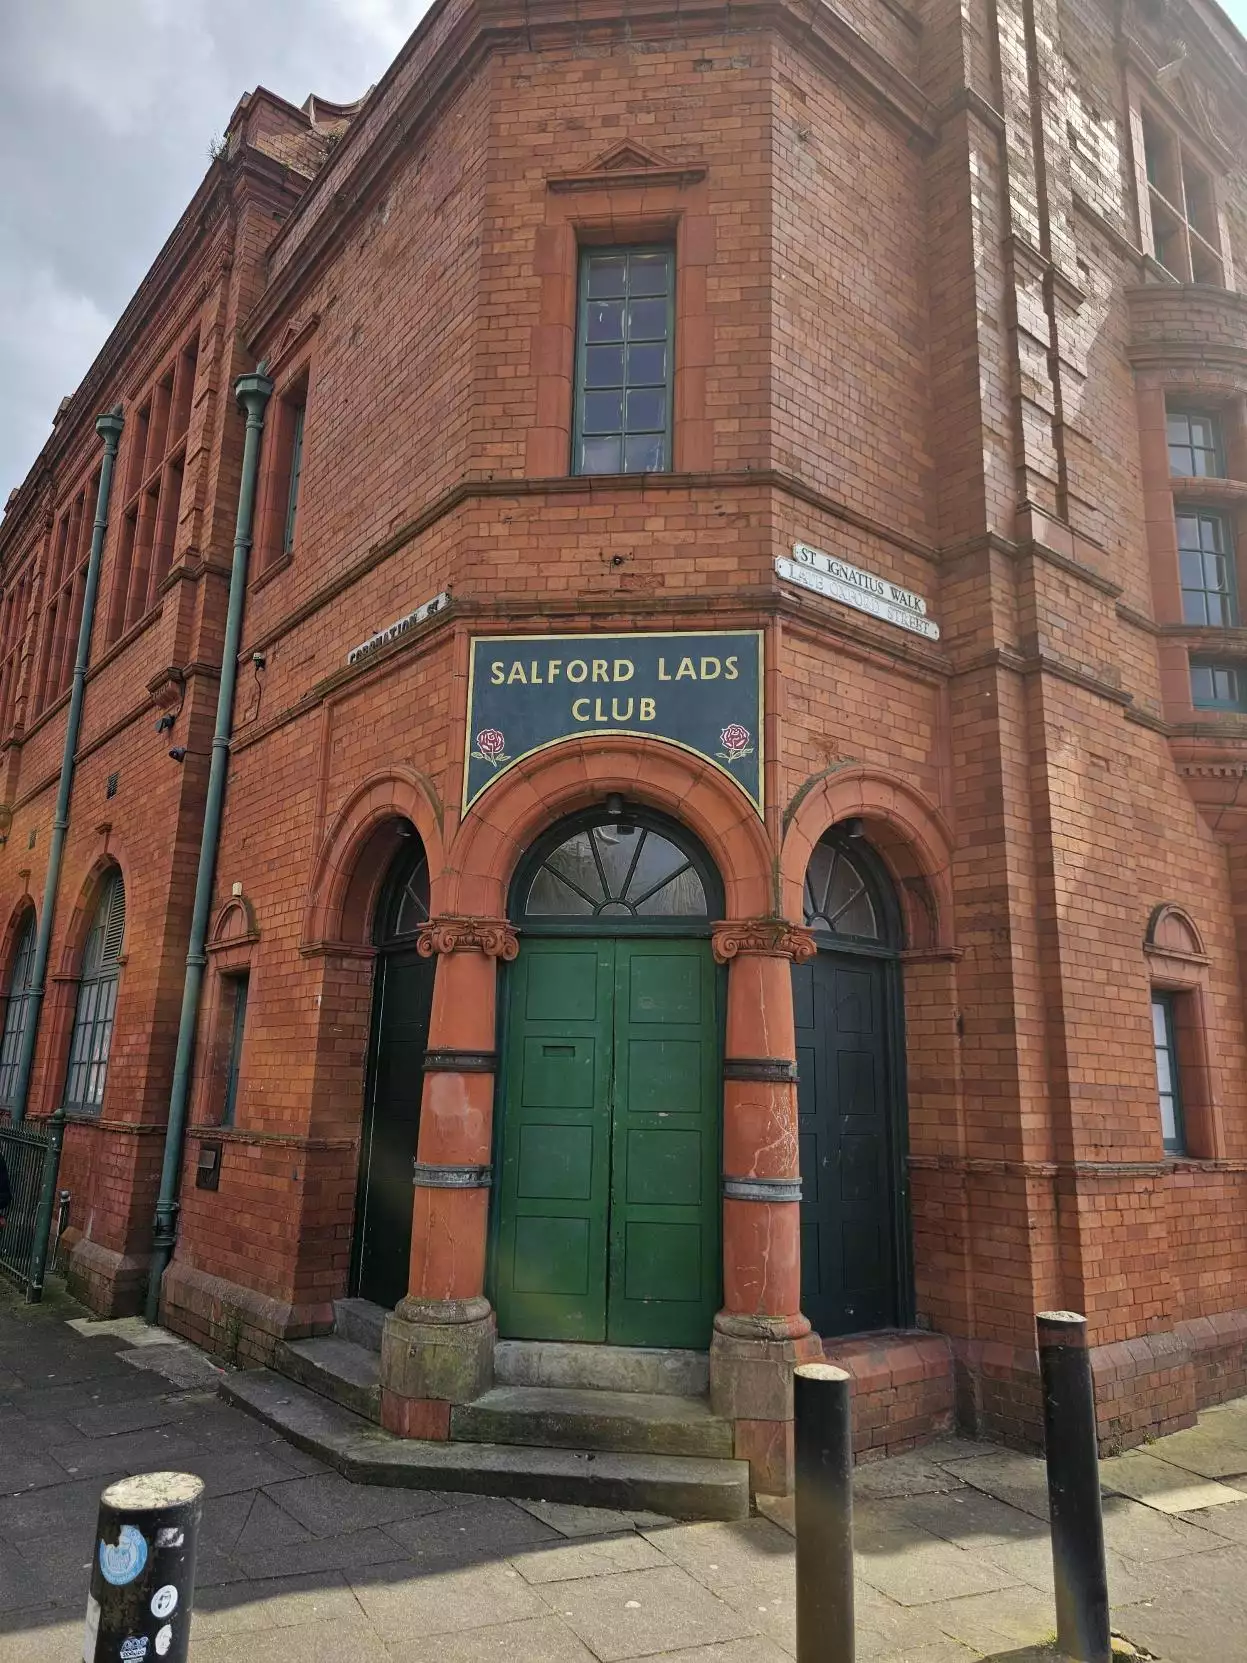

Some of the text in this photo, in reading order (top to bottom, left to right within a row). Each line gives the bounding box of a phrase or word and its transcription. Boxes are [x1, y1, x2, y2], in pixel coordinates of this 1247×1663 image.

[788, 564, 930, 635] LATE OXFORD STREET
[800, 547, 922, 613] ST IGNATIUS WALK
[490, 656, 739, 685] SALFORD LADS
[571, 697, 657, 721] CLUB
